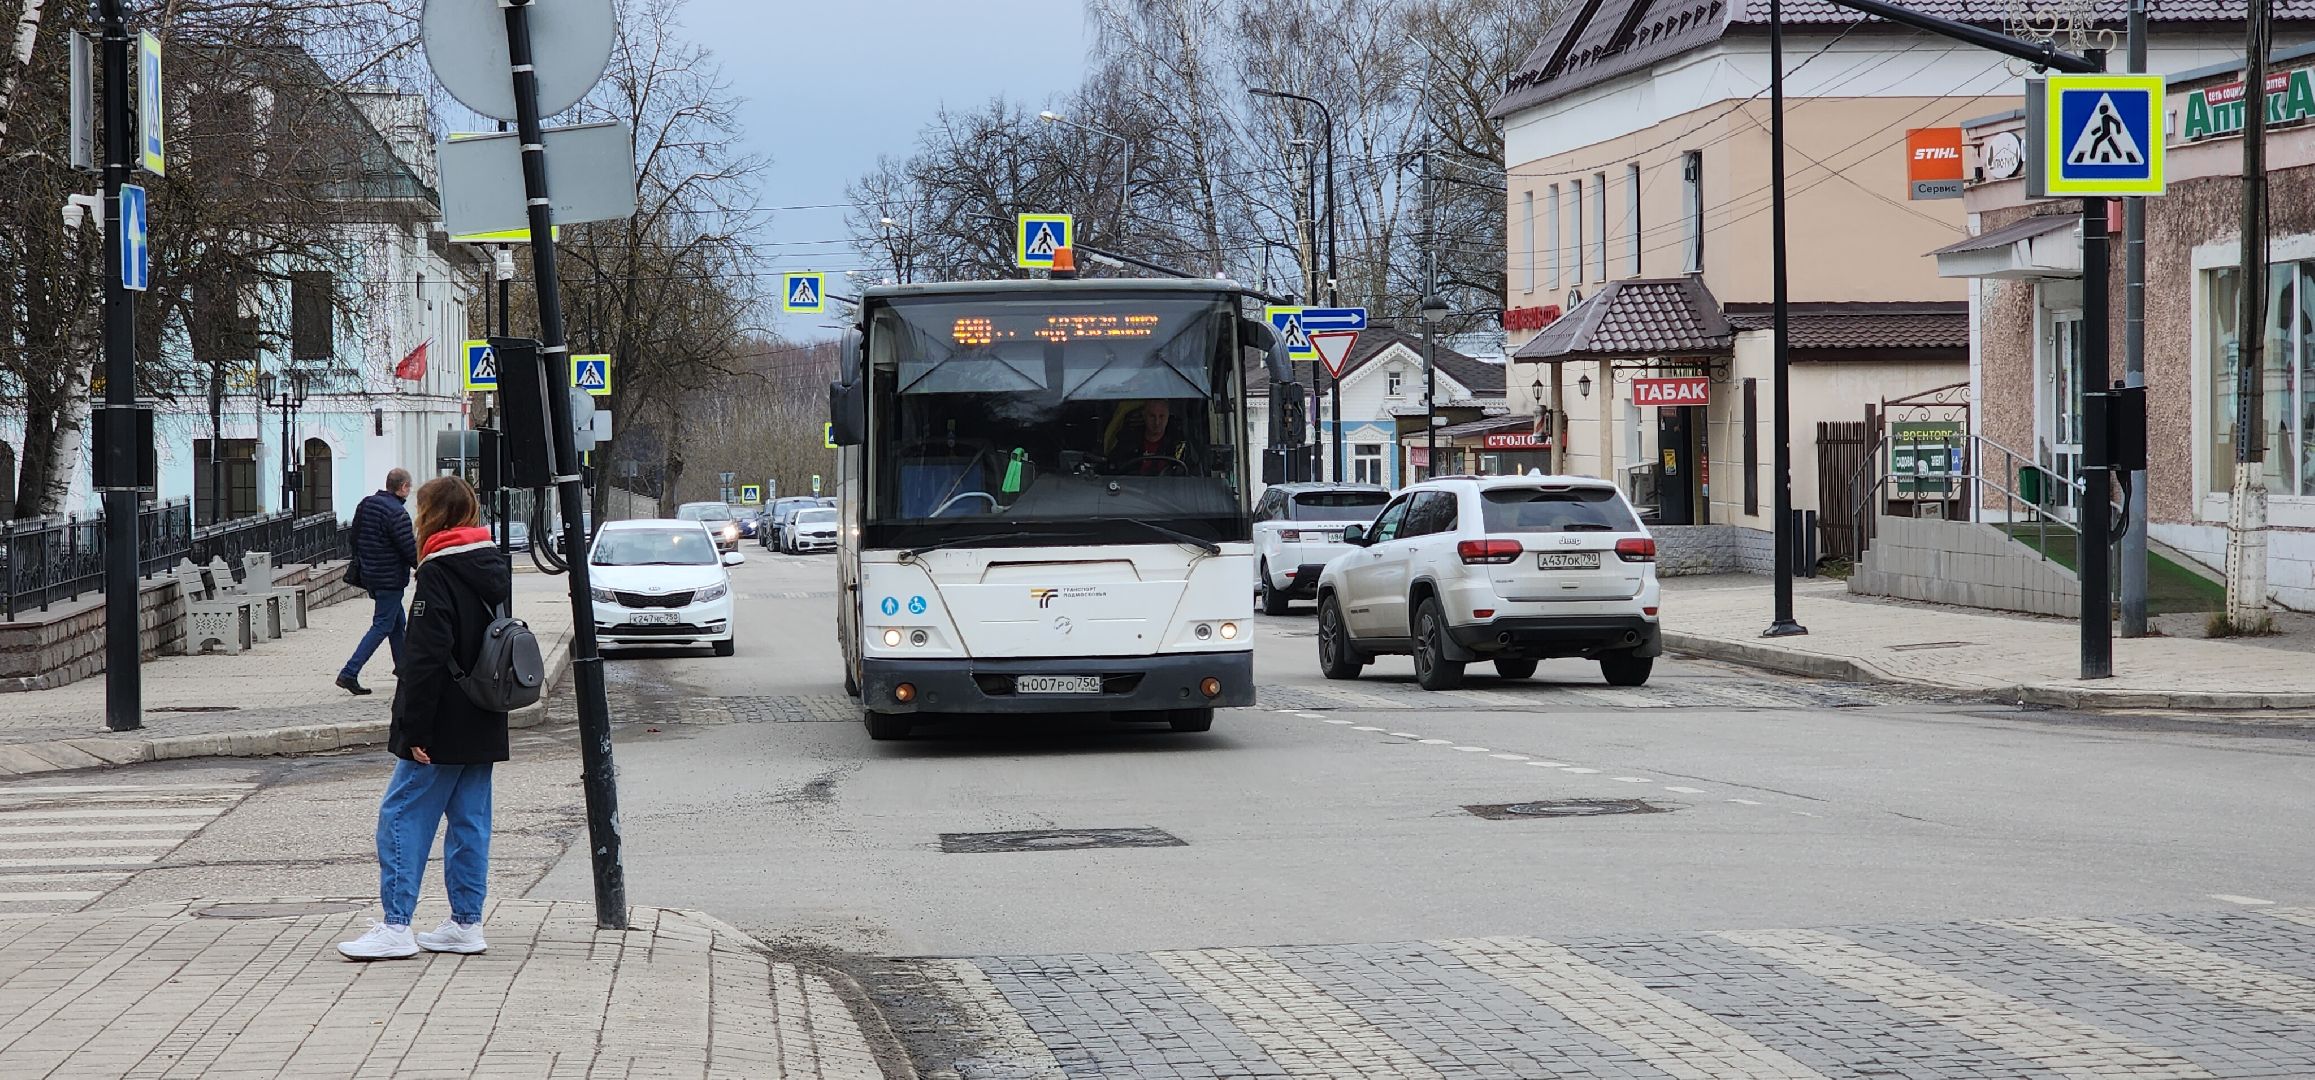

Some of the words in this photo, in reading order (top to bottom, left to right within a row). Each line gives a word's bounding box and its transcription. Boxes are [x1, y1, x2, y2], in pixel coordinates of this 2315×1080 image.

[2266, 76, 2287, 90] аптек
[2184, 70, 2315, 139] АПТКА
[1914, 147, 1959, 160] STIHL
[1918, 184, 1957, 194] Сервис
[1636, 383, 1706, 401] ТАБАК
[1488, 435, 1552, 447] СТОЛОА
[1559, 537, 1581, 545] Jeep
[1542, 555, 1580, 566] А437ОК
[1583, 554, 1597, 562] 790
[1021, 678, 1074, 691] Н007РО
[1077, 678, 1097, 688] 750
